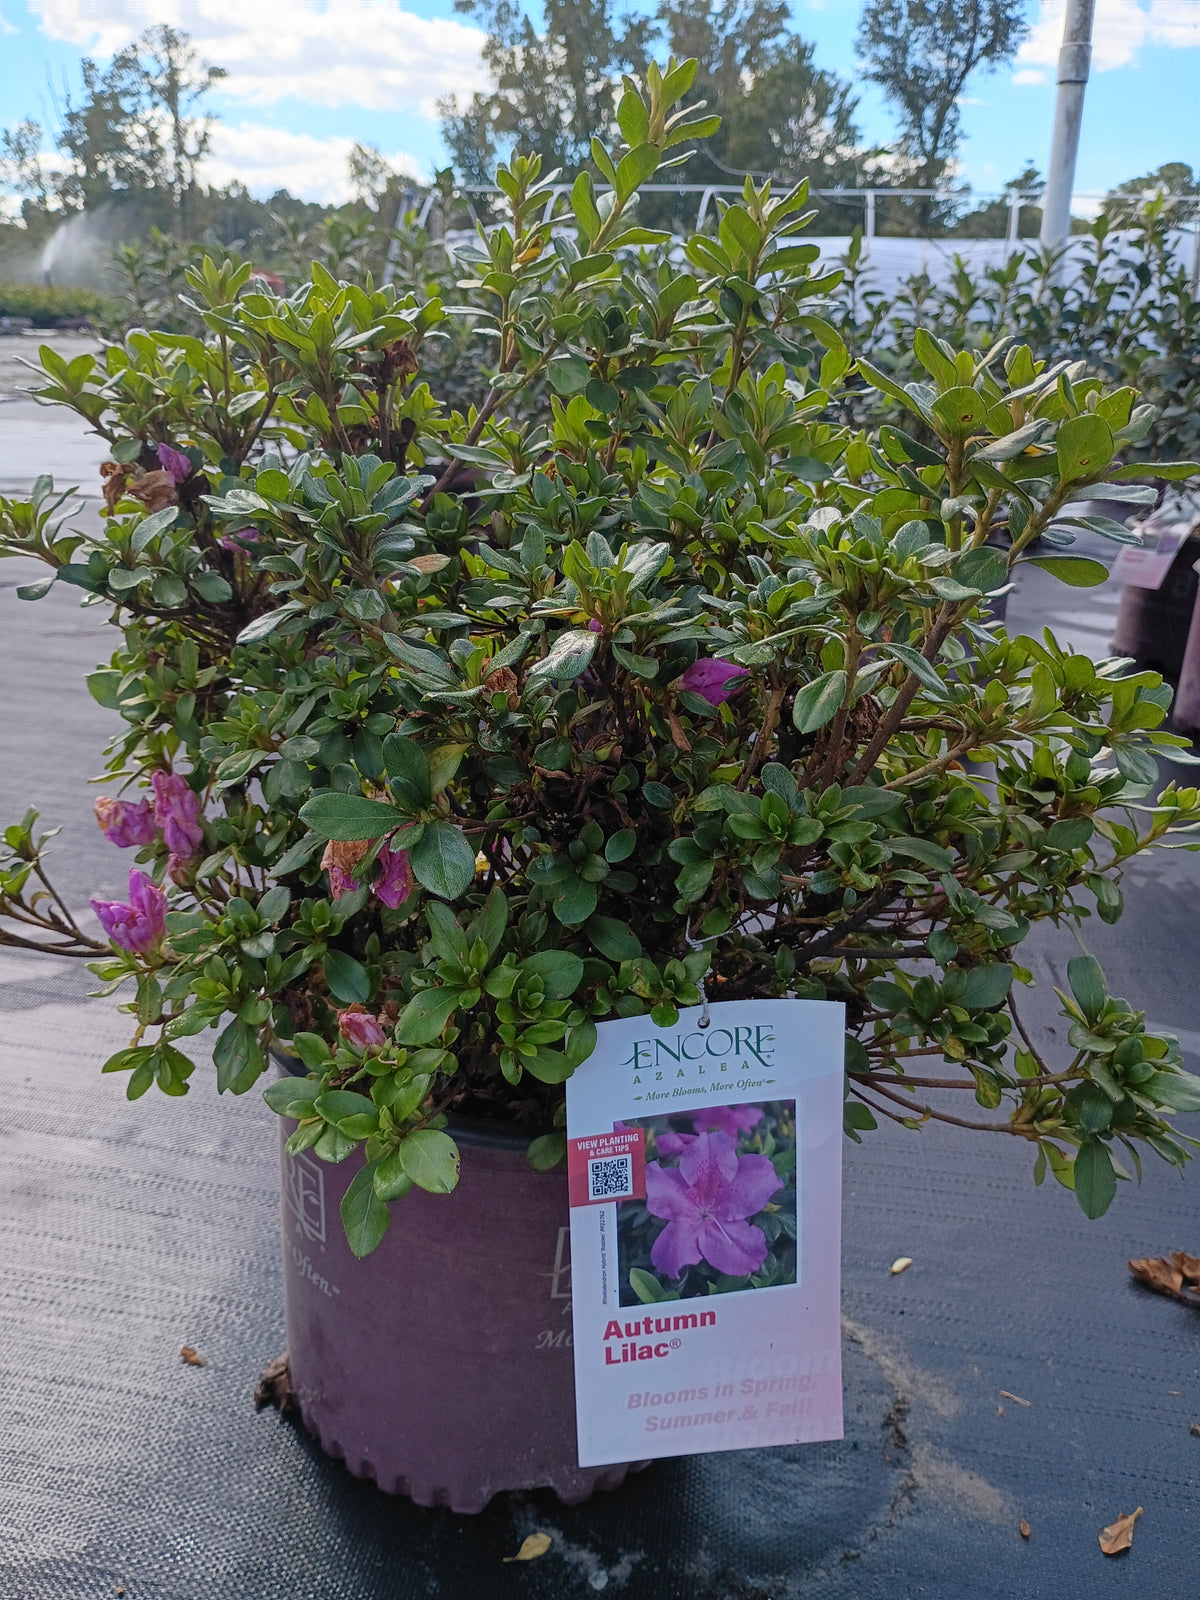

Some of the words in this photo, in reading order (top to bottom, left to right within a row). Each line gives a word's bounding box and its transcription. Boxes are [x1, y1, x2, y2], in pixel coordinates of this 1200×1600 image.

[620, 1025, 775, 1069] ENCORE
[633, 1060, 750, 1084] AZALEA
[645, 1091, 670, 1101] More
[672, 1086, 707, 1097] Blooms,
[710, 1082, 734, 1092] More
[577, 1139, 598, 1150] VIEW
[599, 1133, 639, 1147] PLANTING
[589, 1149, 595, 1157] &
[596, 1146, 614, 1156] CARE
[615, 1143, 630, 1153] TIPS
[603, 1310, 716, 1341] Autumn
[627, 1386, 709, 1410] Blooms
[714, 1381, 735, 1399] in
[740, 1374, 817, 1397] Spring,
[645, 1409, 737, 1432] Summer
[741, 1403, 759, 1421] &
[765, 1397, 813, 1419] Fall!
